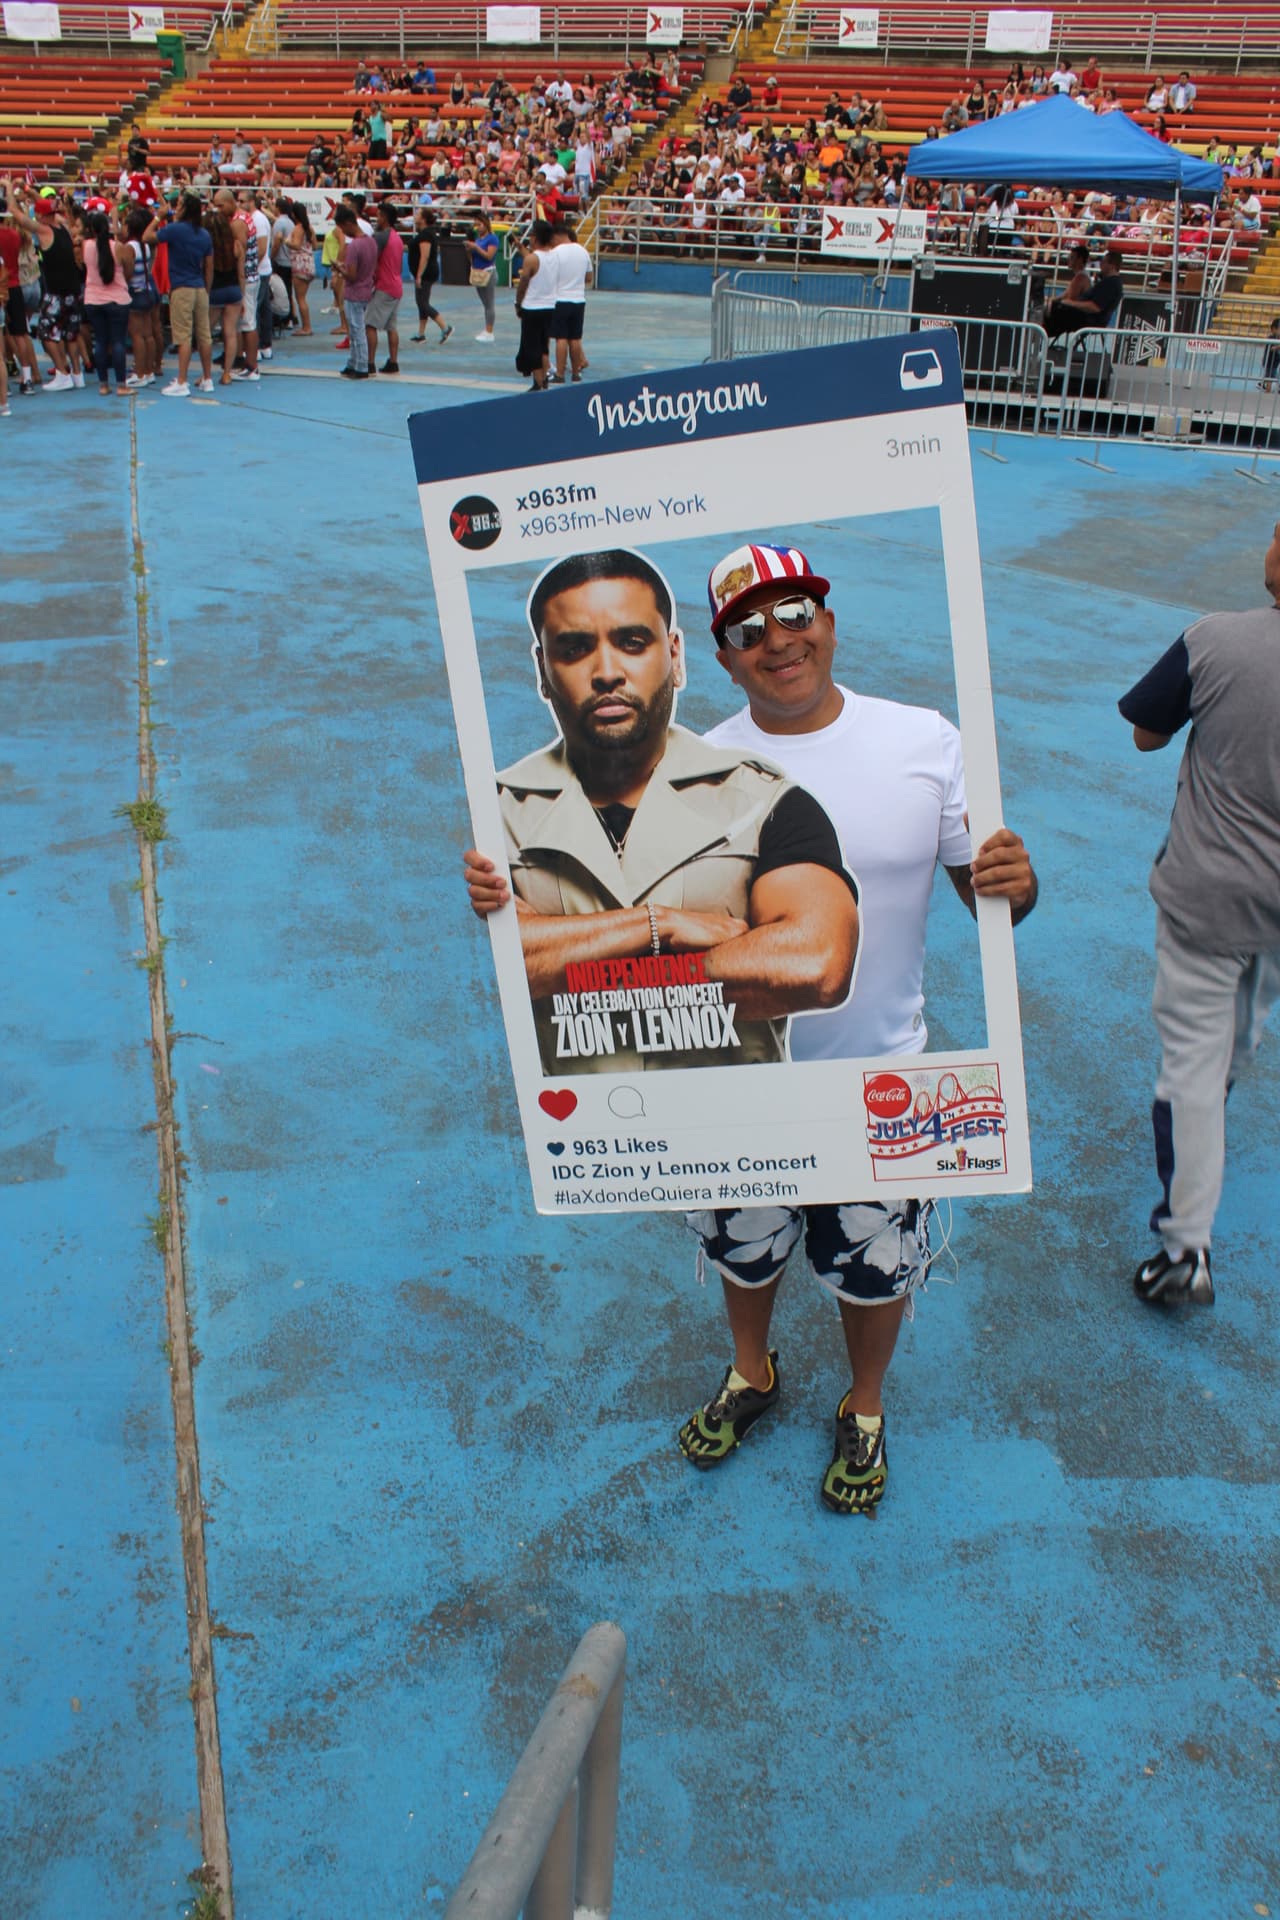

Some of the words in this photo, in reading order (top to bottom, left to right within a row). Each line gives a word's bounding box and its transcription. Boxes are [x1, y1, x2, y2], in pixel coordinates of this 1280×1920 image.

[1187, 340, 1220, 350] NATIONAL
[588, 381, 768, 436] Instagram
[886, 434, 942, 459] 3min
[516, 484, 597, 511] x963fm
[519, 504, 652, 538] x963fm-New
[658, 493, 707, 517] York
[565, 952, 710, 993] INDEPENDENCE
[553, 993, 578, 1015] DAY
[580, 986, 665, 1014] CELEBRATION
[665, 982, 724, 1008] CONCERT
[550, 1012, 616, 1058] ZION
[616, 1023, 628, 1046] Y
[631, 1003, 742, 1054] LENNOX
[872, 1112, 922, 1140] JULY
[919, 1111, 948, 1144] 4
[950, 1118, 1002, 1145] FEST
[573, 1139, 608, 1156] 963
[614, 1137, 669, 1155] Likes
[552, 1165, 586, 1180] IDC
[592, 1162, 634, 1179] Zion
[640, 1165, 651, 1180] y
[657, 1158, 731, 1177] Lennox
[737, 1153, 818, 1173] Concert
[936, 1159, 958, 1171] Six
[966, 1157, 1002, 1172] Flags
[554, 1186, 713, 1206] #laXdondeQuiera
[717, 1181, 799, 1200] #x963fm
